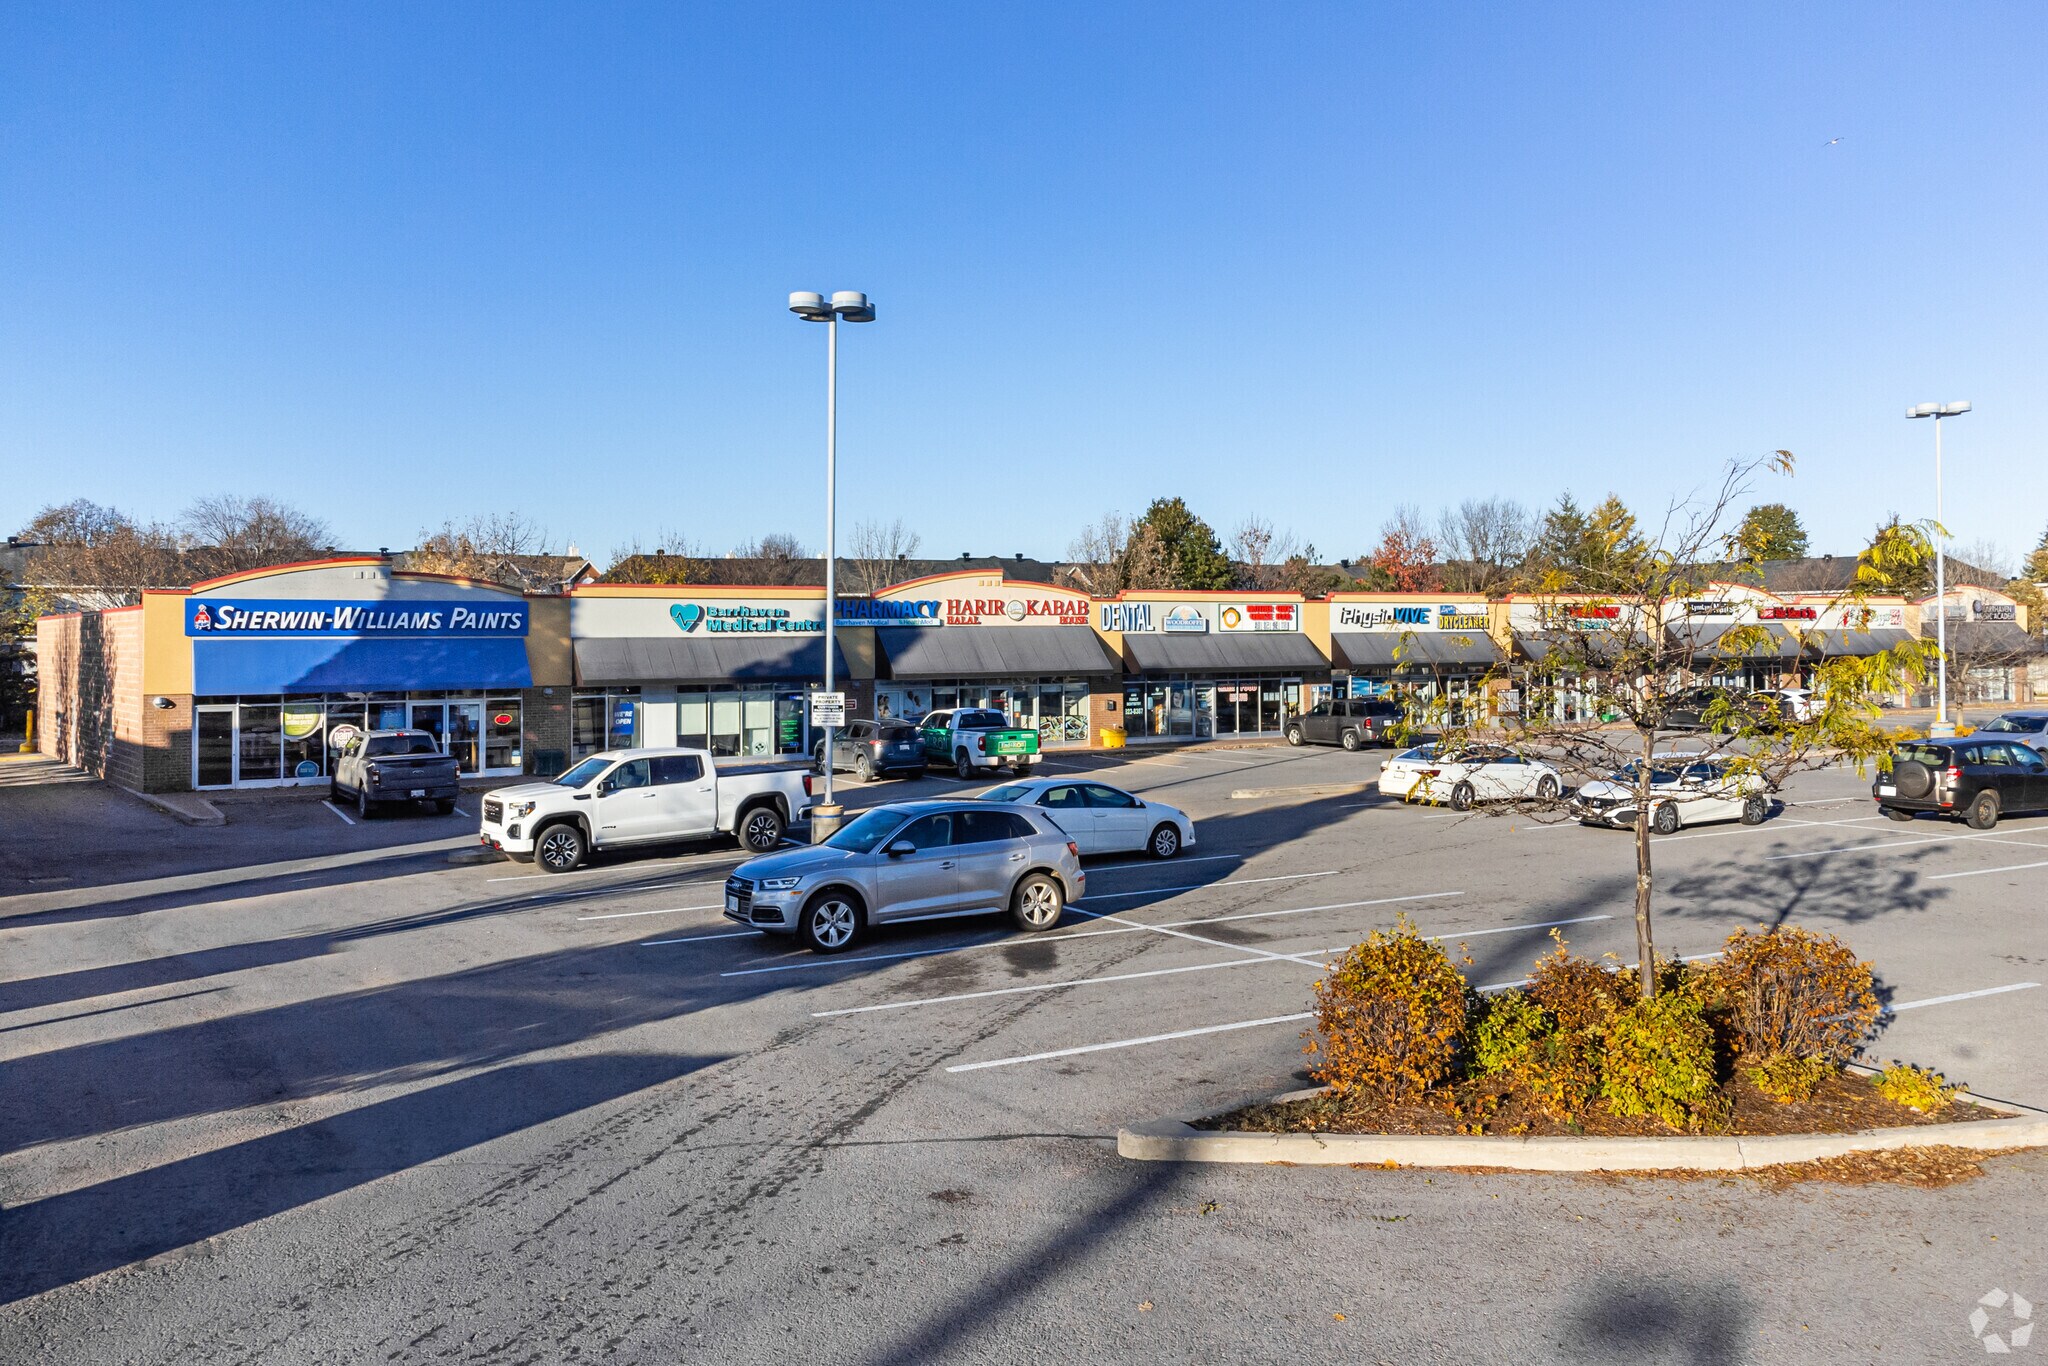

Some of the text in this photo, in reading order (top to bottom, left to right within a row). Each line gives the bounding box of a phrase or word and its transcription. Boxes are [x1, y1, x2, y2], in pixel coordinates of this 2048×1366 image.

[706, 604, 786, 617] Barrhaven
[833, 599, 939, 619] PHARMACY
[946, 599, 1090, 616] HARIR KABAB
[947, 615, 1089, 625] HALAL HOUSE
[1100, 603, 1154, 631] DENTAL
[1439, 615, 1490, 629] DRYCLEANER
[706, 617, 827, 632] Medical Centre
[615, 717, 632, 725] OPEN
